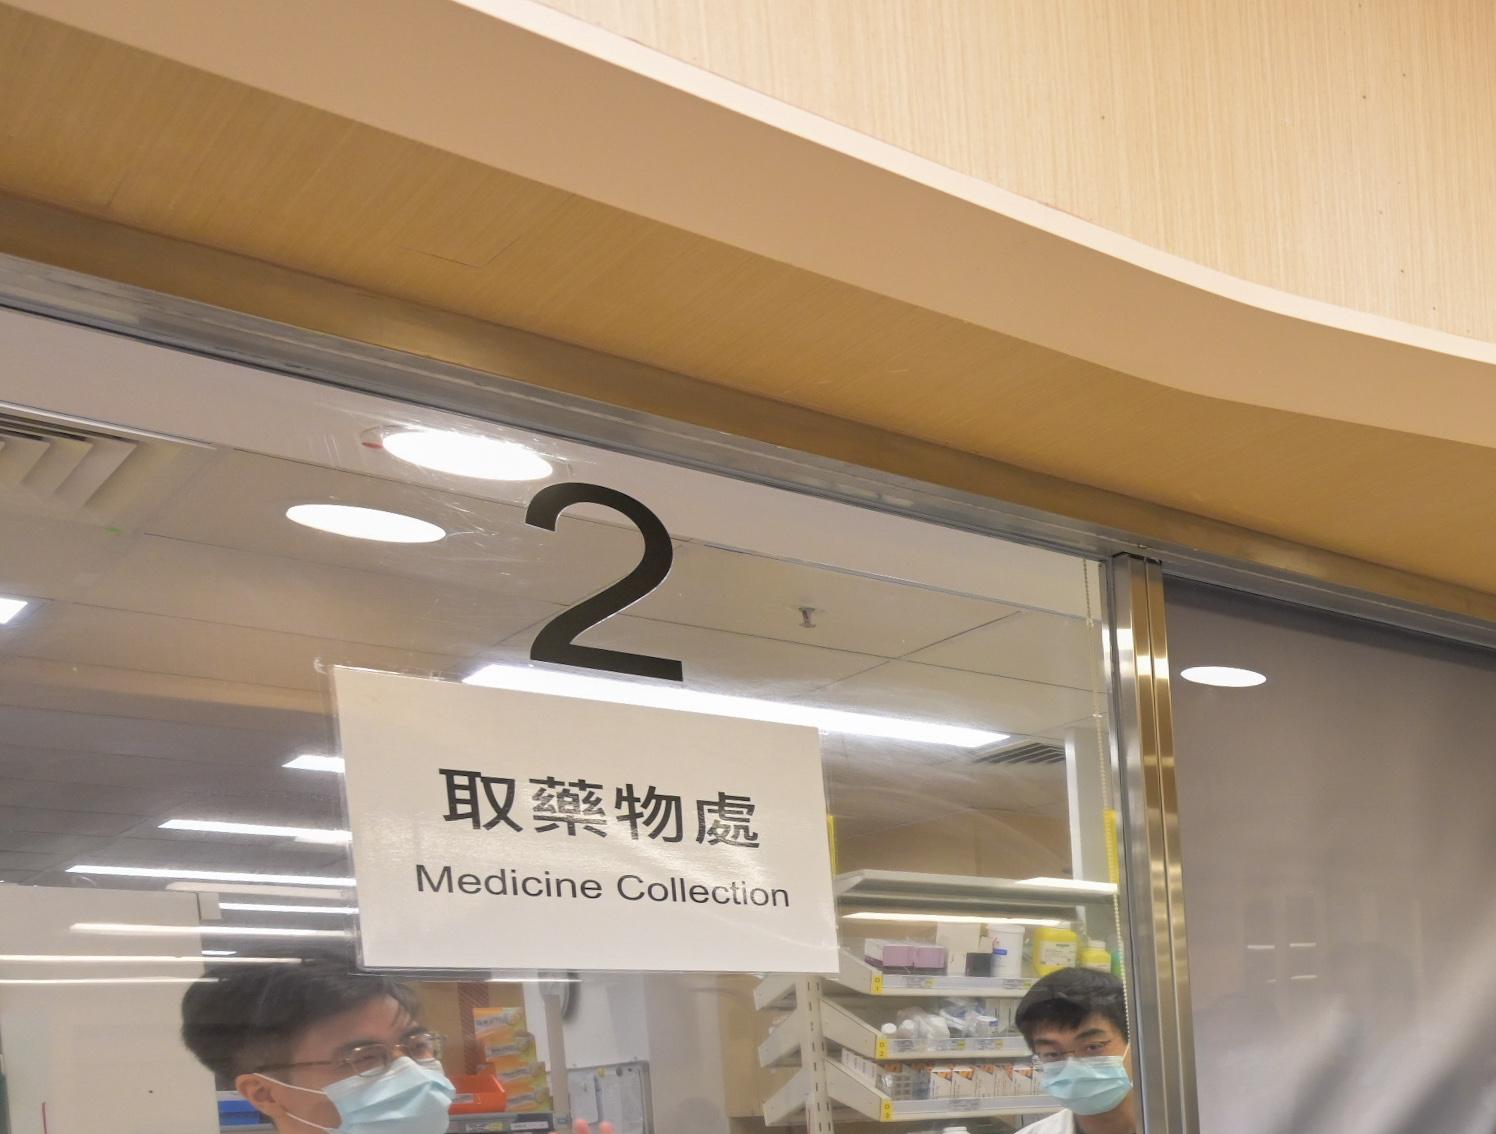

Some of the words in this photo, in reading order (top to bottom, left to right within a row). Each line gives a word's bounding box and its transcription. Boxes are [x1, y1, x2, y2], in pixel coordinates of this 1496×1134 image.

[525, 482, 684, 683] 2
[438, 768, 761, 849] 取藥物處
[416, 864, 603, 901] Medicine
[616, 873, 790, 908] Collection
